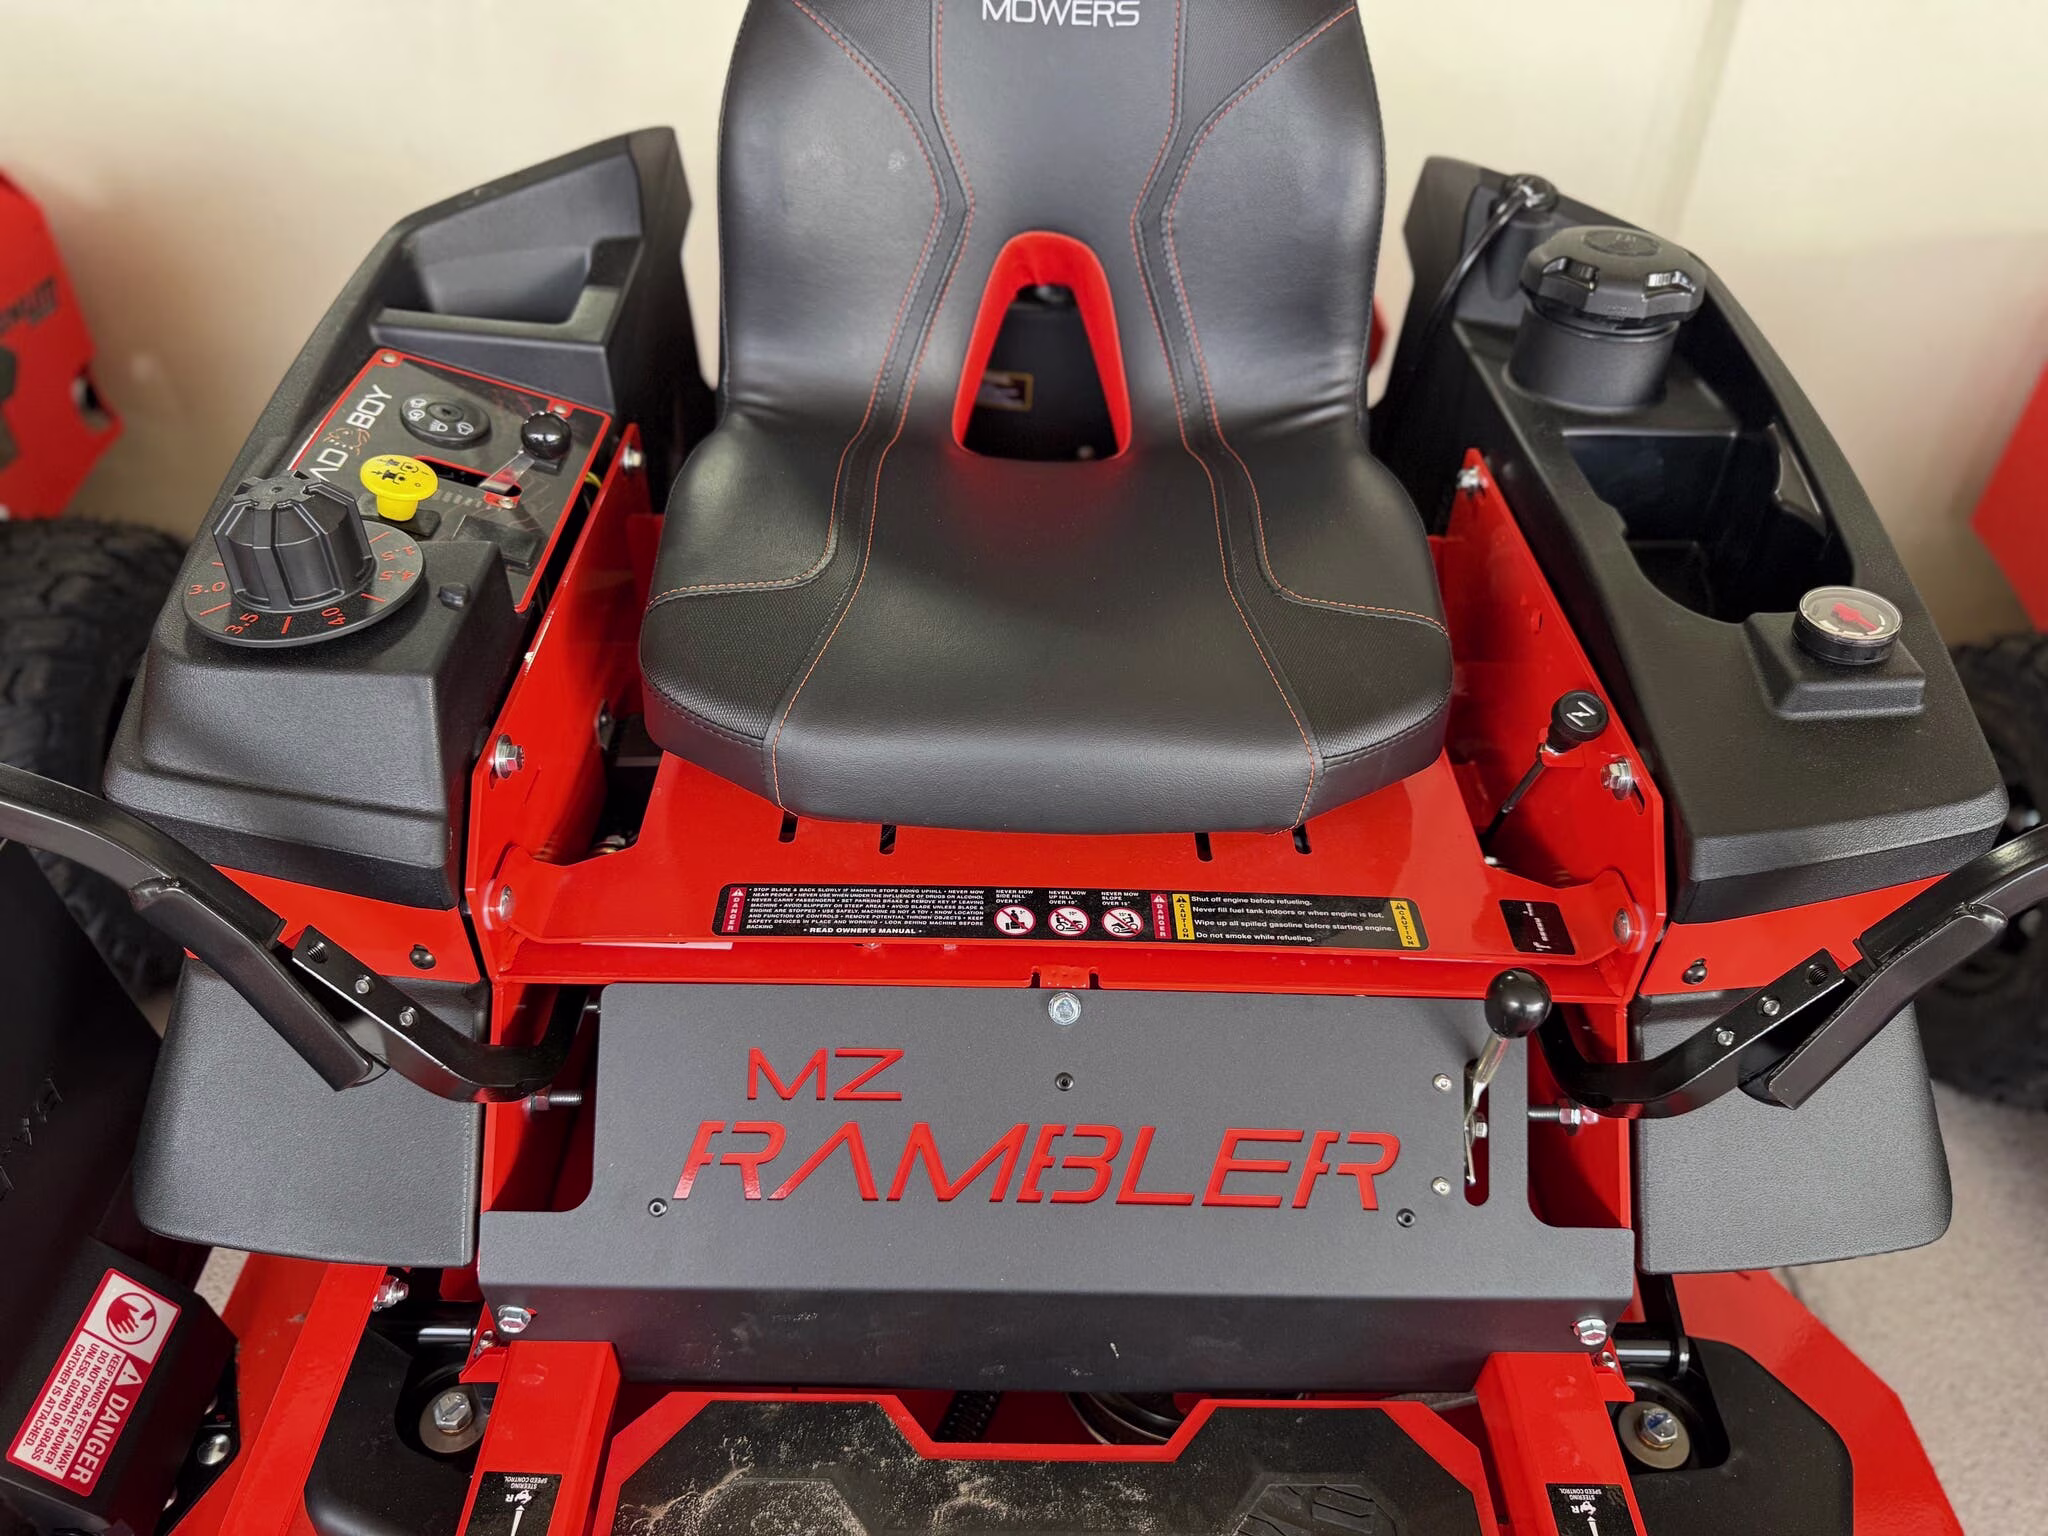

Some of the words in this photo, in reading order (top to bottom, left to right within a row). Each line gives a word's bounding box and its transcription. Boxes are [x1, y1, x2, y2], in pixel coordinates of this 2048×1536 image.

[982, 0, 1140, 28] MOWERS
[346, 384, 392, 430] BOY
[188, 581, 226, 595] 3.0
[378, 570, 416, 582] 4.5
[224, 612, 260, 634] 3.5
[321, 607, 347, 626] 4.0
[727, 897, 739, 930] DANGER
[1156, 903, 1166, 936] DANGER
[1180, 904, 1189, 938] CAUTION
[1399, 911, 1414, 945] CAUTION
[748, 1046, 904, 1100] MZ
[672, 1120, 1401, 1211] RAMBLER
[58, 1344, 85, 1385] CATCHER
[76, 1343, 100, 1378] UNLESS
[97, 1350, 109, 1364] DO
[107, 1353, 120, 1377] KEEP
[52, 1385, 64, 1396] IS
[89, 1365, 104, 1385] NOT
[58, 1379, 80, 1411] GUARD
[64, 1384, 91, 1426] OPERATE
[88, 1376, 110, 1409] HANDS
[23, 1396, 56, 1446] ATTACHED.
[49, 1412, 62, 1426] OR
[71, 1418, 88, 1442] FEET
[32, 1428, 54, 1461] GRASS
[44, 1428, 69, 1464] MOWER
[70, 1392, 130, 1484] DANGER
[54, 1442, 75, 1472] AWAY.
